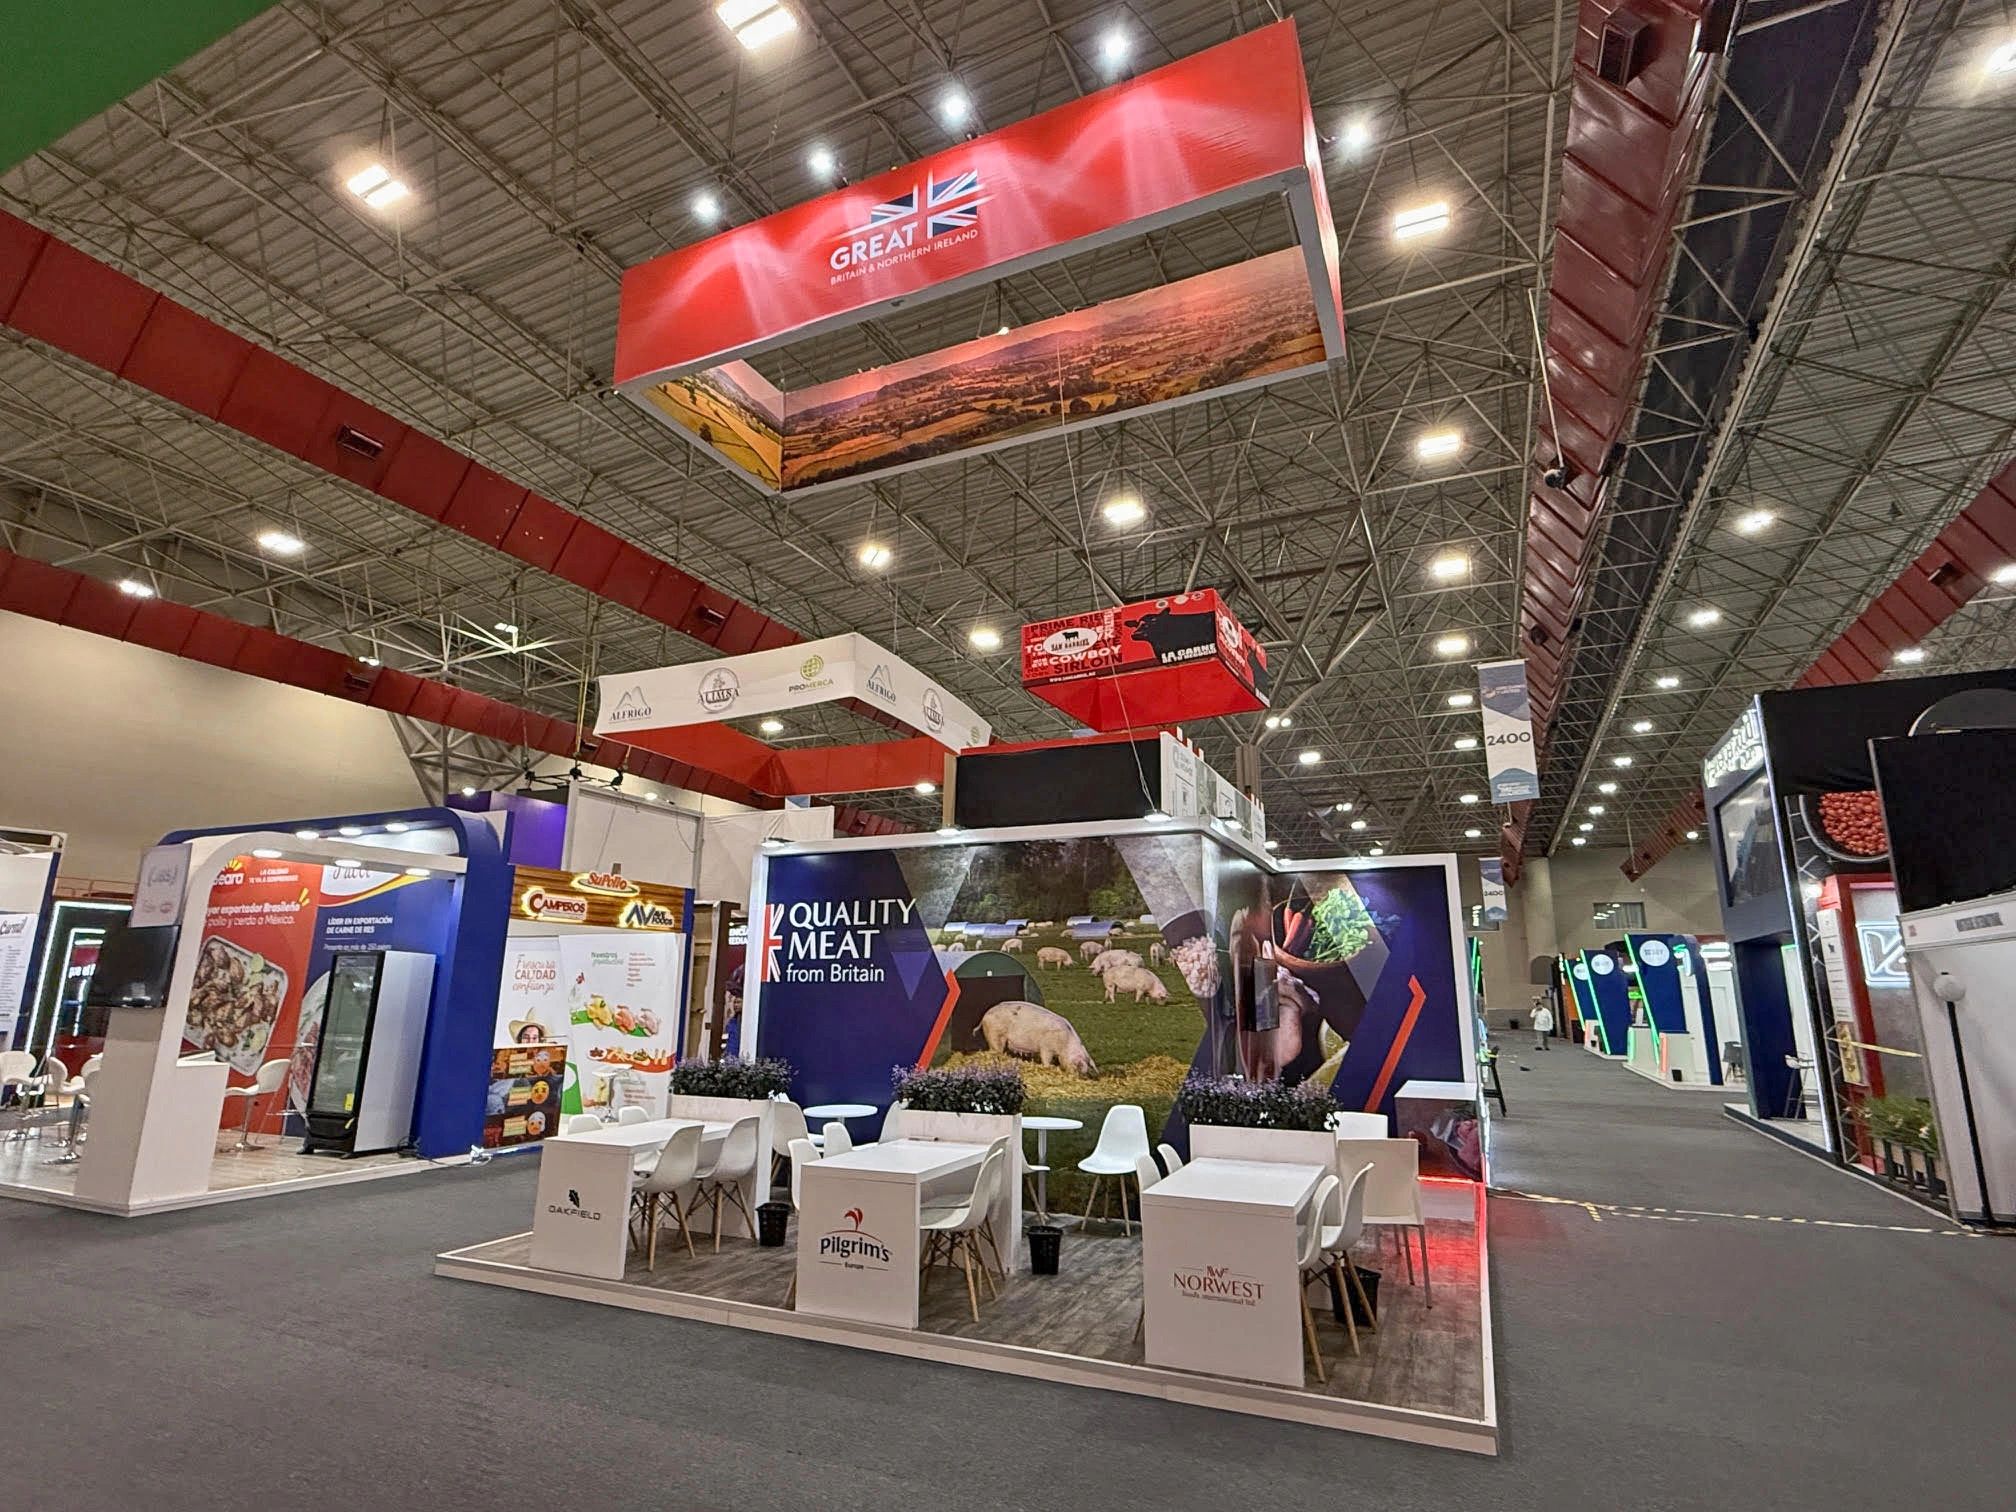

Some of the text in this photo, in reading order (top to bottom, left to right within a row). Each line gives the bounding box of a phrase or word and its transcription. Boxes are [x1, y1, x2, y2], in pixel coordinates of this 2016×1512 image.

[830, 222, 918, 270] GREAT
[830, 229, 978, 285] BRITAIN & NORTHERN IRELAND
[1049, 644, 1122, 666] COWBOY
[1054, 654, 1123, 675] SIRLOIN
[1161, 651, 1177, 664] LA
[788, 678, 834, 693] PROMERCA
[609, 706, 652, 721] ALFRIGO
[1486, 731, 1531, 746] 2400
[529, 893, 585, 914] CAMPEROS
[789, 898, 917, 930] QUALITY
[788, 929, 880, 960] MEAT
[514, 969, 556, 980] CALIDAD
[786, 963, 885, 982] from Britain
[548, 1205, 601, 1221] OAKFIELD
[820, 1236, 890, 1262] Pilgrim's
[1173, 1272, 1265, 1300] NORWEST
